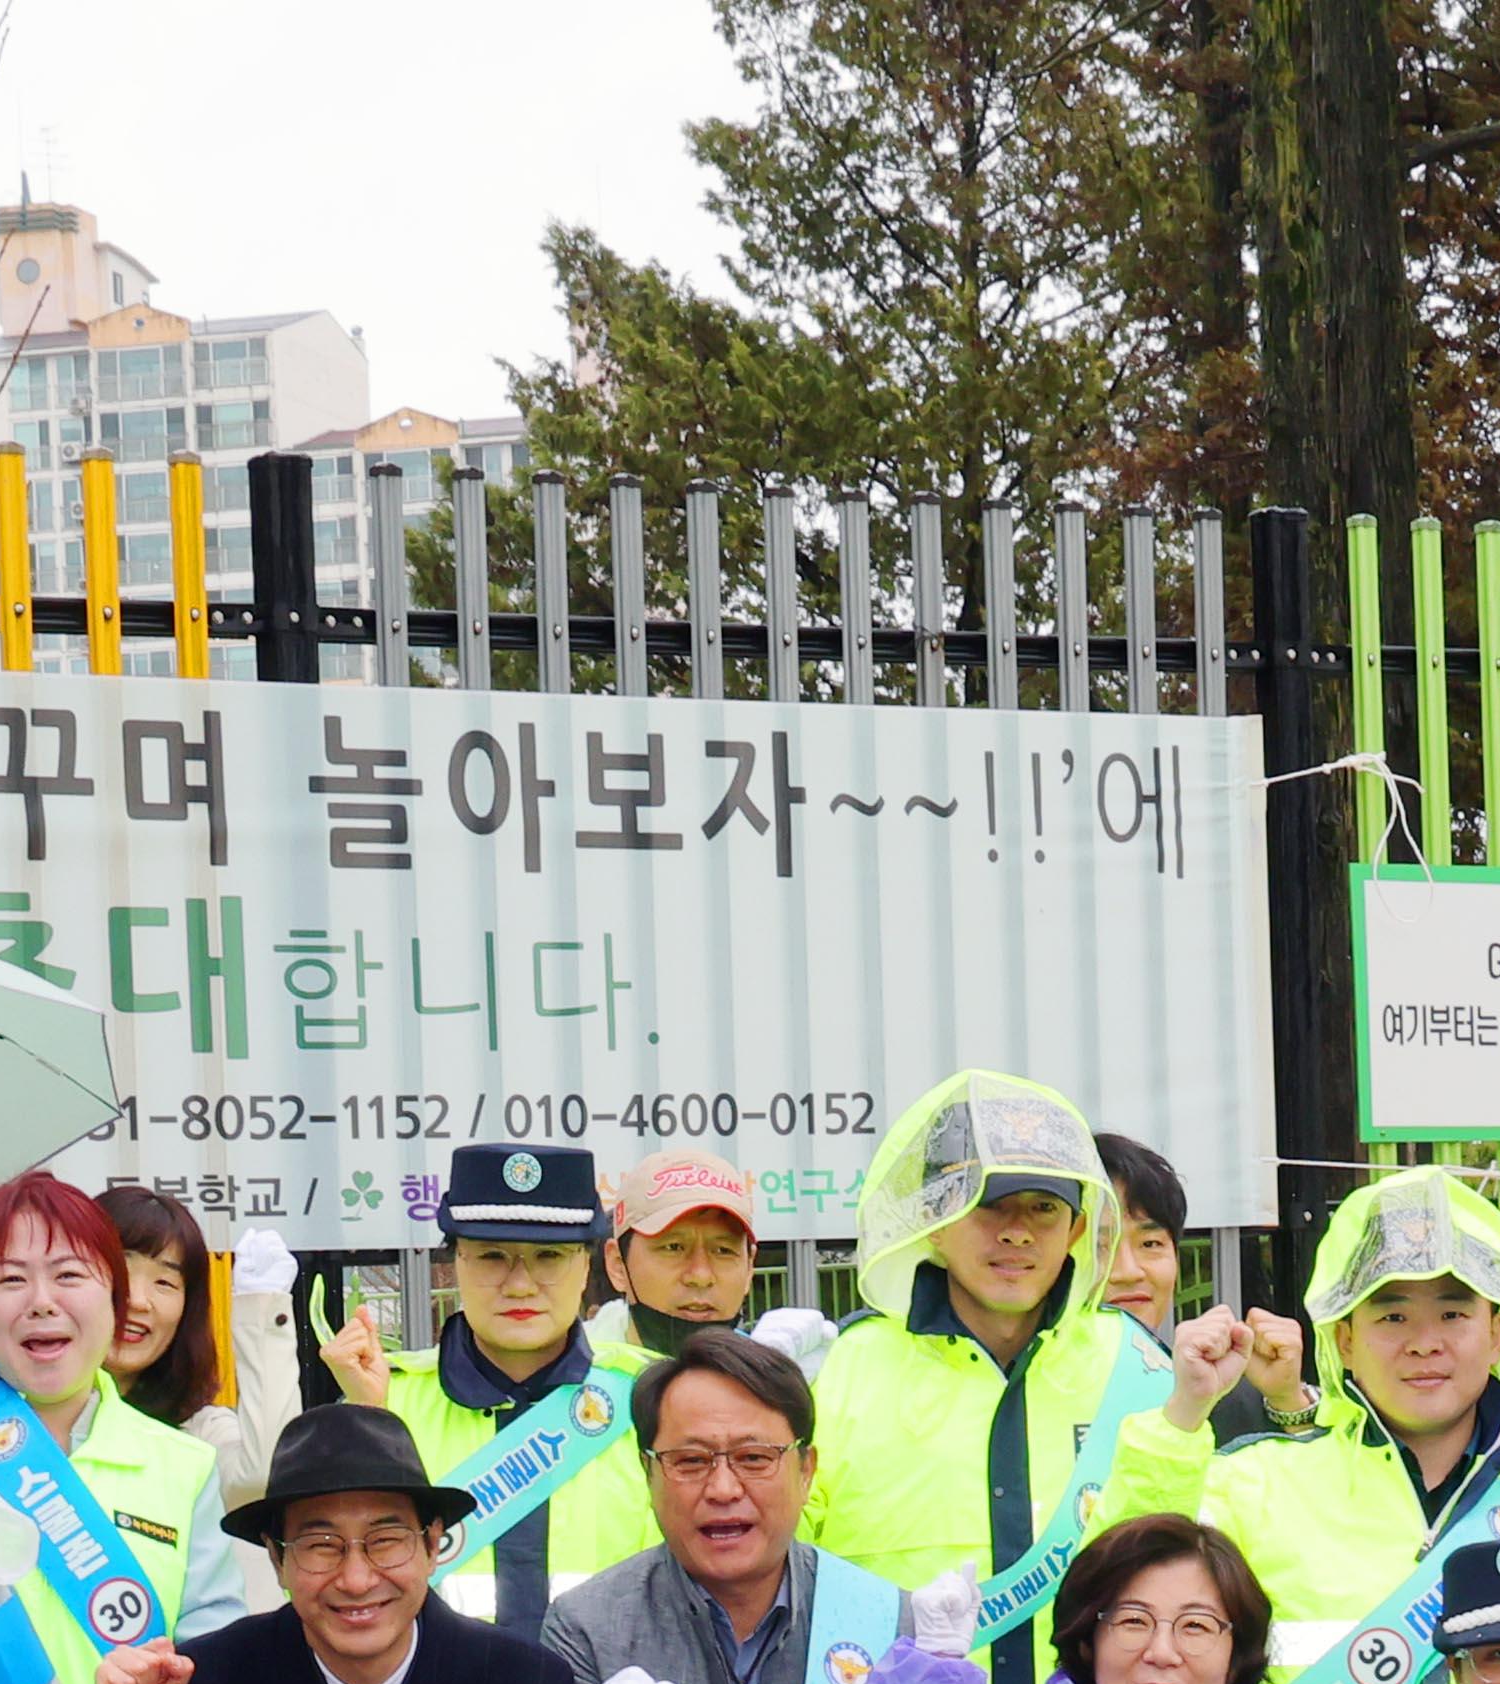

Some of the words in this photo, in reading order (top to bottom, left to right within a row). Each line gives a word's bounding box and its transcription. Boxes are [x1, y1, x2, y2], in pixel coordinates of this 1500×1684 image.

[1381, 1005, 1499, 1047] 여기부터는
[503, 1091, 877, 1138] 010-4600-0152
[99, 1590, 143, 1633] 30
[1355, 1638, 1402, 1684] 30
